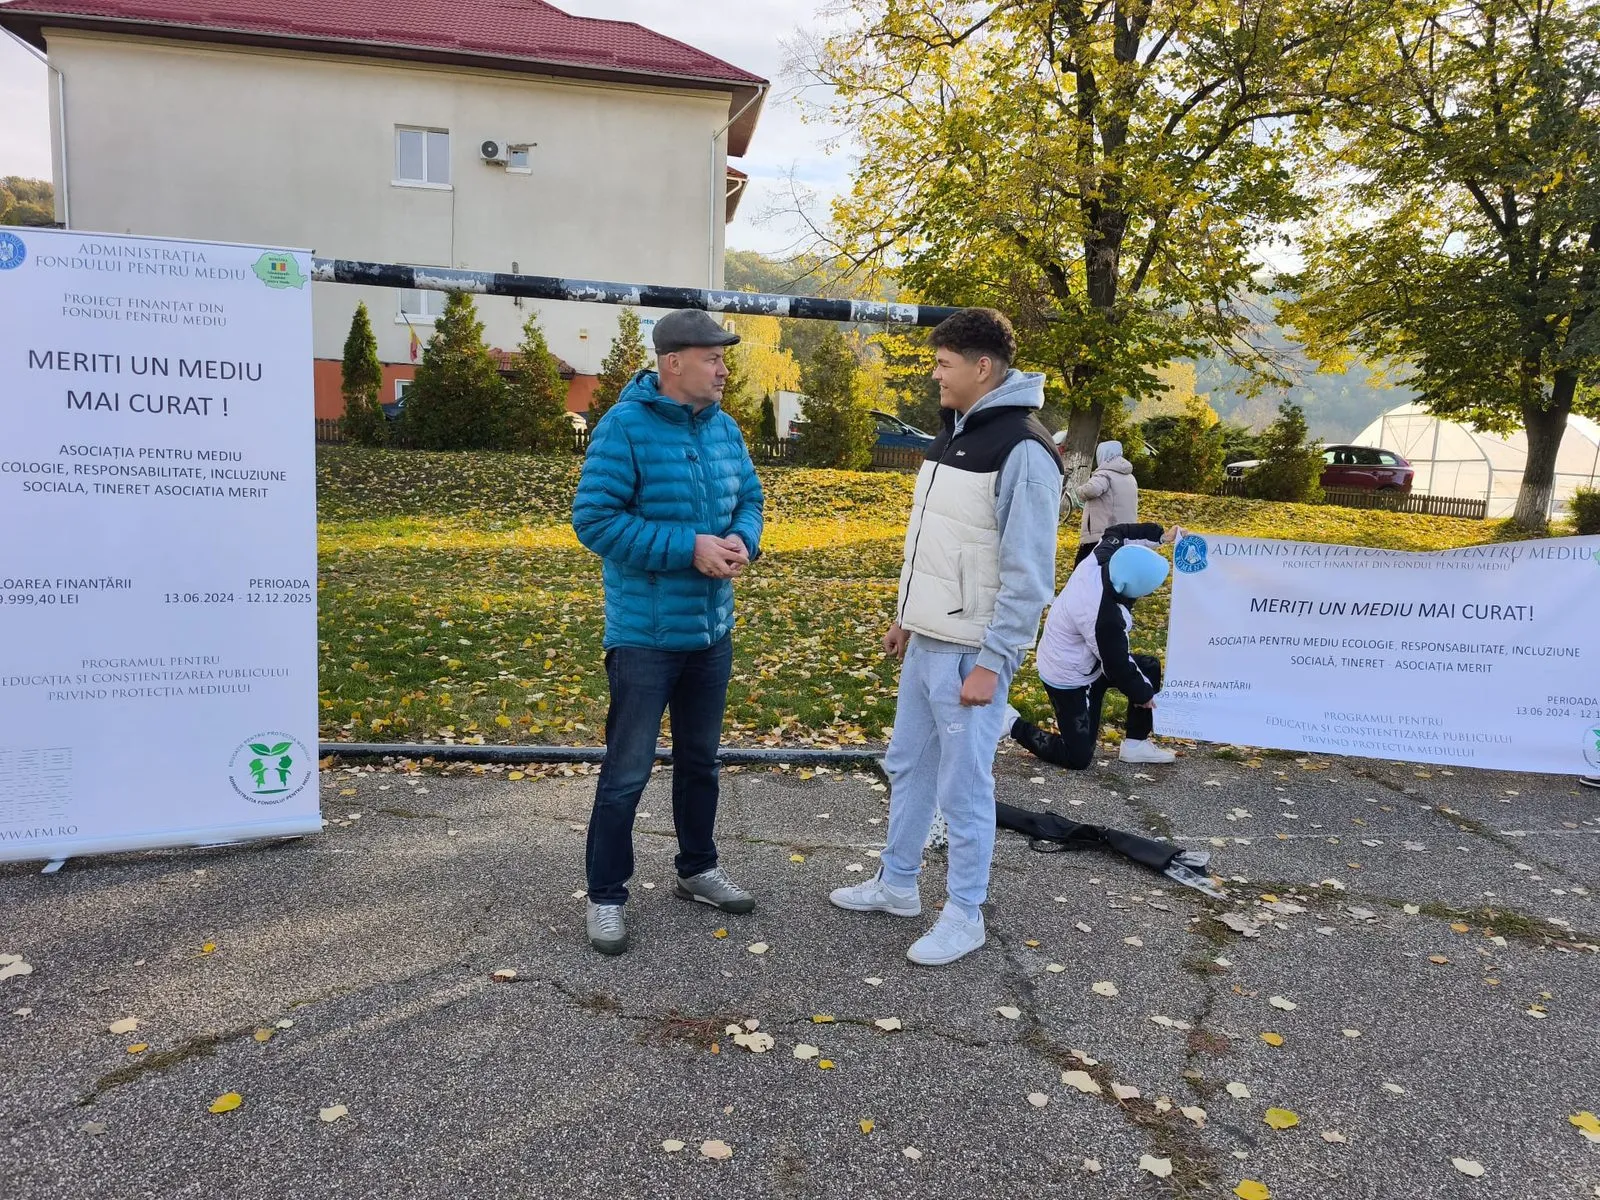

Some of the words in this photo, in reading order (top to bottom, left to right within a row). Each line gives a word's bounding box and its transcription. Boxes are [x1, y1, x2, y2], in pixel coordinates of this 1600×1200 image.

[36, 256, 121, 272] FONDULUI
[128, 262, 189, 277] PENTRU
[194, 267, 246, 281] MEDIU
[64, 294, 122, 306] PROIECT
[199, 303, 224, 313] DIN
[62, 306, 121, 320] FONDUL
[126, 311, 178, 324] PENTRU
[183, 315, 227, 326] MEDIU
[28, 349, 122, 374] MERITI
[131, 356, 169, 376] UN
[179, 358, 262, 381] MEDIU
[67, 390, 119, 412] MAI
[129, 394, 213, 416] CURAT
[223, 398, 228, 416] !
[59, 445, 135, 459] ASOCIAȚIA
[139, 448, 193, 460] PENTRU
[197, 450, 242, 462] MEDIU
[2, 462, 68, 476] COLOGIE,
[74, 464, 206, 480] RESPONSABILITATE,
[211, 468, 287, 481] INCLUZIUNE
[23, 481, 88, 494] SOCIALA,
[93, 483, 150, 495] TINERET
[228, 486, 269, 498] MERIT
[1529, 546, 1591, 560] MEDIU
[1283, 560, 1321, 568] PROIECT
[1372, 560, 1390, 568] DIN
[1394, 560, 1432, 569] FONDUL
[1436, 562, 1474, 570] PENTRU
[1478, 563, 1511, 571] MEDIU
[249, 579, 310, 588] PERIOADA
[60, 594, 79, 604] LEI
[164, 593, 234, 604] 13.06.2024
[247, 594, 312, 604] 12.12.2025
[1250, 598, 1312, 616] MERIȚI
[1320, 602, 1346, 615] UN
[1351, 602, 1413, 616] MEDIU
[1418, 604, 1455, 618] MAI
[1462, 604, 1534, 621] CURAT!
[1260, 636, 1300, 646] PENTRU
[1304, 638, 1338, 647] MEDIU
[1342, 639, 1397, 650] ECOLOGIE,
[1402, 641, 1507, 656] RESPONSABILITATE,
[1512, 646, 1580, 657] INCLUZIUNE
[82, 656, 166, 669] PROGRAMUL
[170, 655, 220, 666] PENTRU
[1291, 655, 1337, 667] SOCIALĂ,
[1341, 658, 1384, 668] TINERET
[1458, 663, 1493, 672] MERIT
[218, 668, 289, 678] PUBLICULUI
[49, 689, 107, 701] PRIVIND
[188, 684, 251, 695] MEDIULUI
[1548, 696, 1598, 706] PERIOADA
[1324, 712, 1394, 724] PROGRAMUL
[1398, 716, 1443, 726] PENTRU
[1302, 735, 1350, 747] PRIVIND
[1418, 746, 1474, 757] MEDIULUI
[1443, 732, 1512, 744] PUBLICULUI
